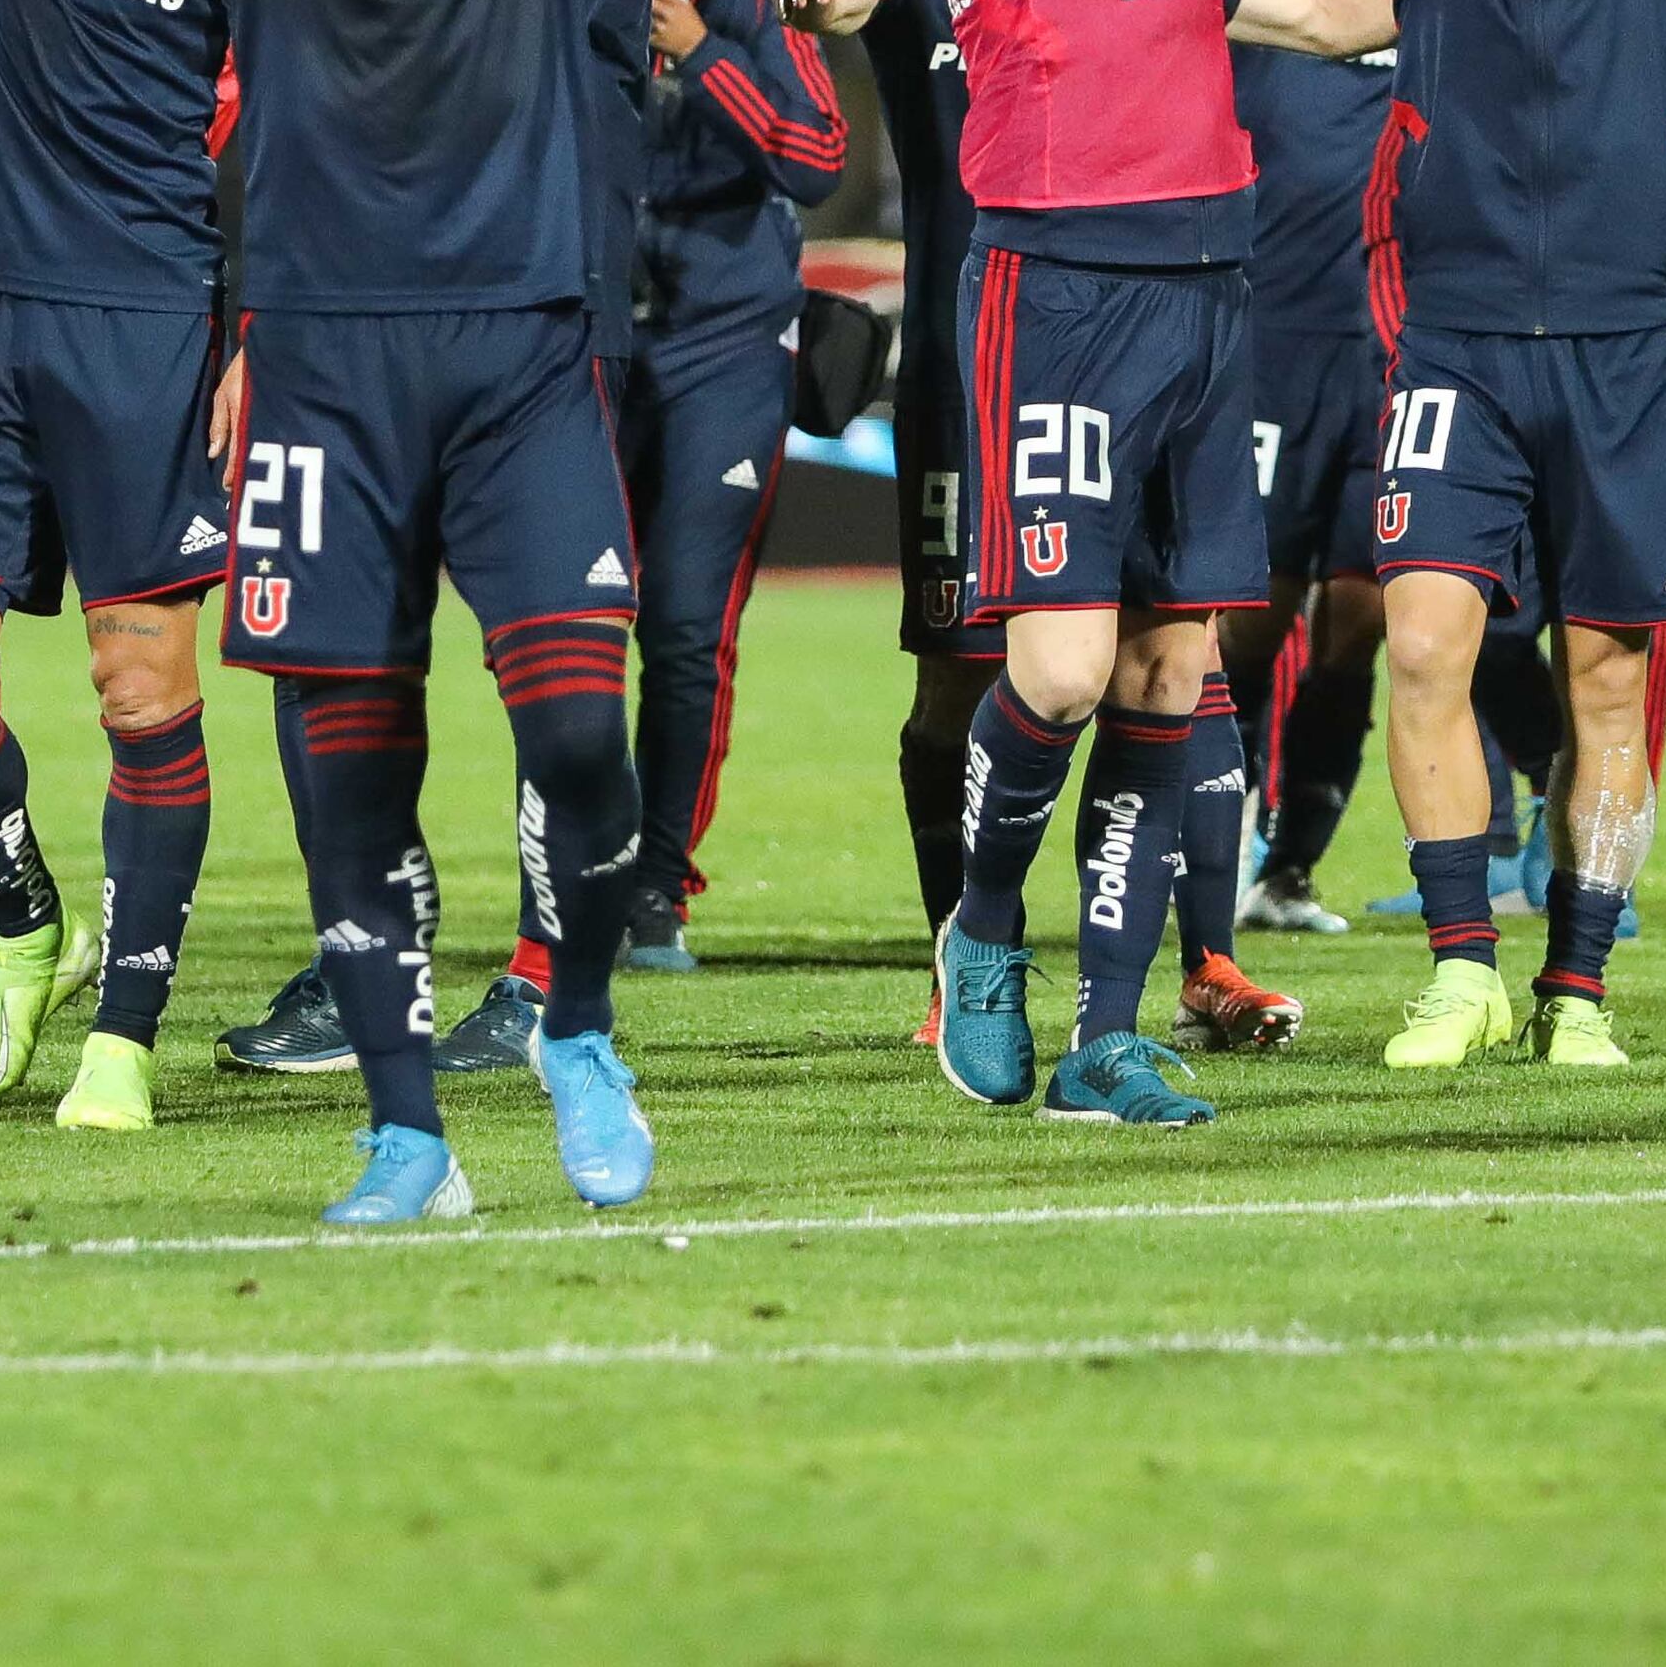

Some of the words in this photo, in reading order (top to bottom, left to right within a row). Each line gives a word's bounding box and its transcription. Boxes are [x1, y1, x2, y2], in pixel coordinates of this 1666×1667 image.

[1013, 402, 1113, 502] 20
[1382, 387, 1459, 473] 10
[236, 440, 325, 553] 21
[1376, 491, 1412, 545] U
[179, 530, 229, 556] adidas
[1020, 520, 1068, 578] U
[241, 575, 292, 637] U
[115, 957, 176, 972] adidas
